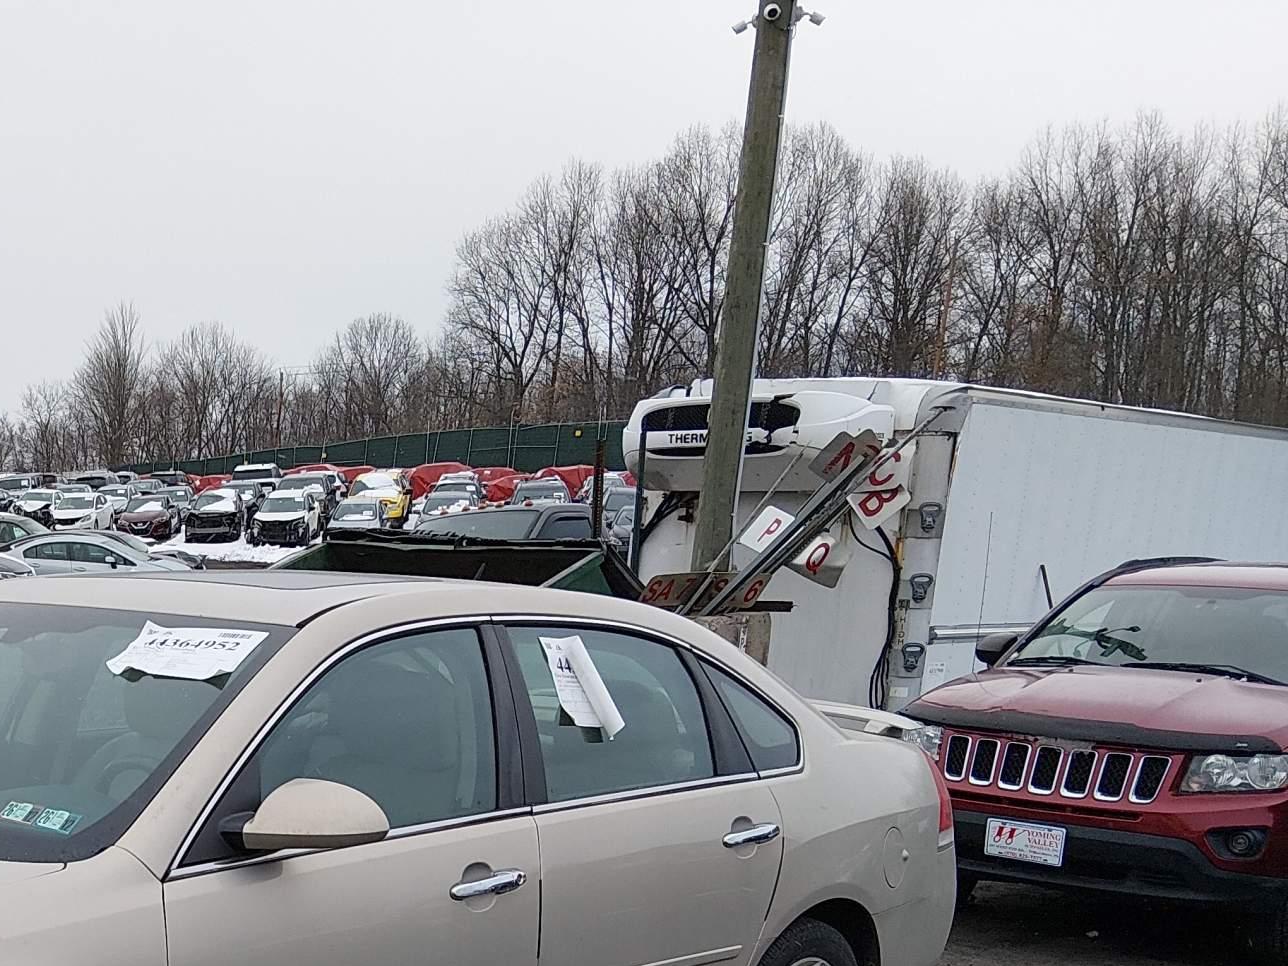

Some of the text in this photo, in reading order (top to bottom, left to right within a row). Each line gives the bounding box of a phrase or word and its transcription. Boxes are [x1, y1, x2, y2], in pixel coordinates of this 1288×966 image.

[668, 433, 708, 444] THERM
[757, 518, 782, 543] P
[805, 542, 831, 575] Q
[743, 579, 763, 602] 6
[556, 657, 574, 674] 44
[1027, 838, 1059, 849] VALLEY
